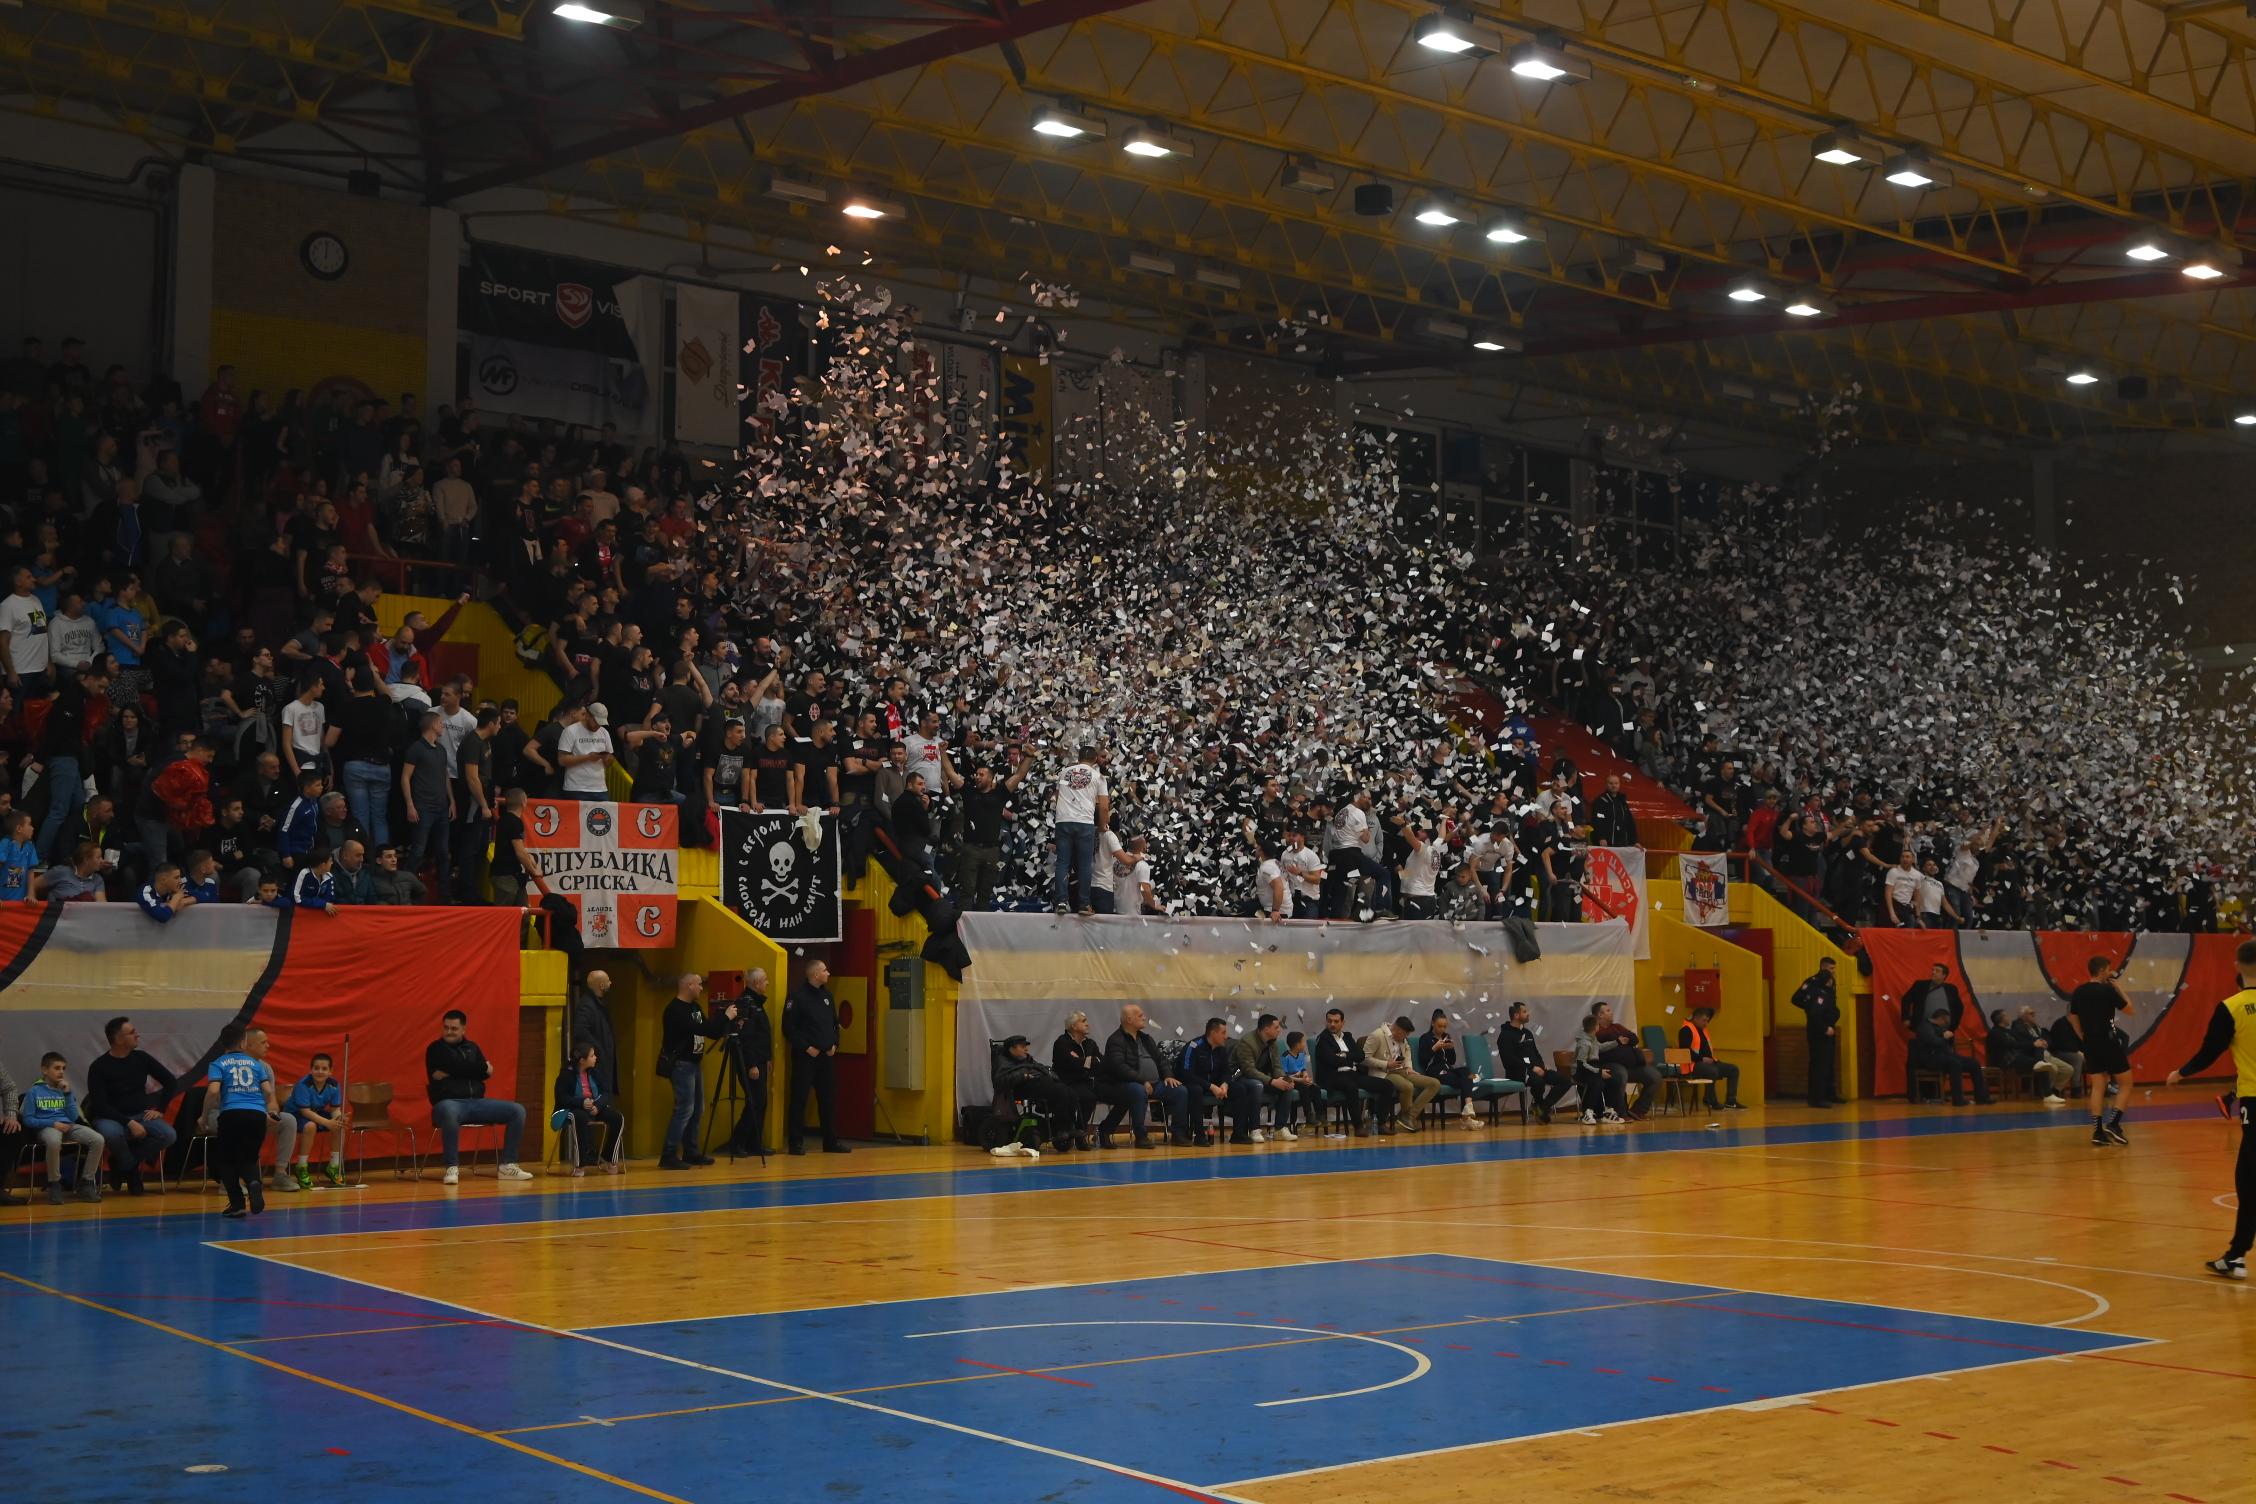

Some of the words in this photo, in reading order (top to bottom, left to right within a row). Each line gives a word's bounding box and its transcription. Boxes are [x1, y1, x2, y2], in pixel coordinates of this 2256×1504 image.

[480, 281, 551, 305] SPORT
[559, 874, 639, 891] СРПСКА
[229, 1066, 254, 1087] 10
